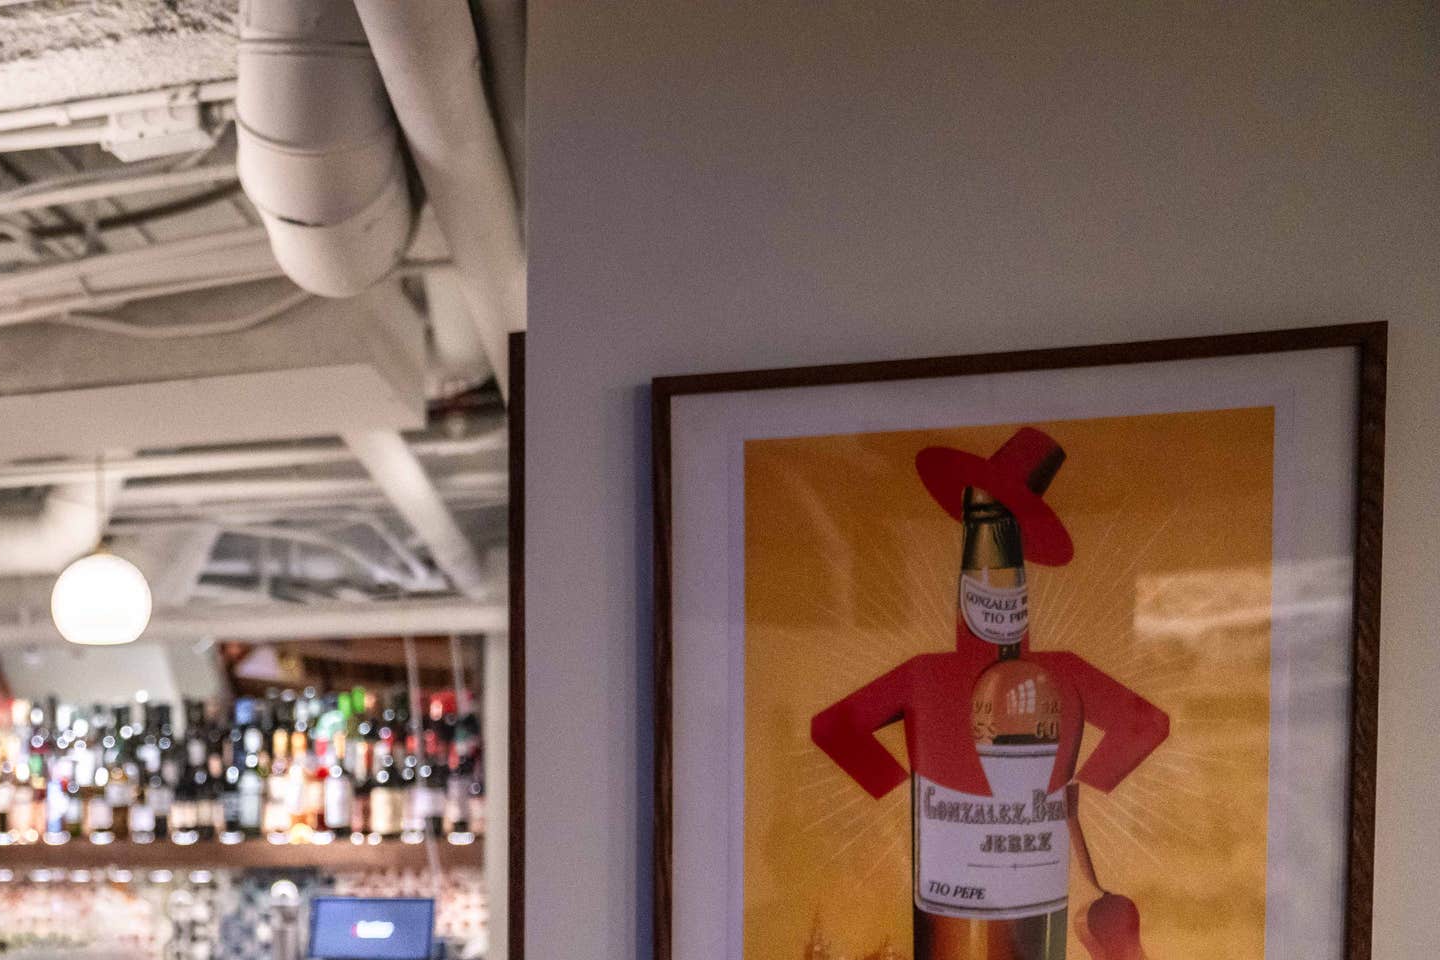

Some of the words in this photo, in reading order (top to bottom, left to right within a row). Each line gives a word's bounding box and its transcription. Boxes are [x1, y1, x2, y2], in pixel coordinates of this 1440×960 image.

[966, 592, 1017, 610] GONZALEZ
[983, 611, 1005, 625] TIO
[980, 832, 1053, 853] JEREZ
[929, 880, 951, 896] TIO
[952, 884, 986, 900] PEPE
